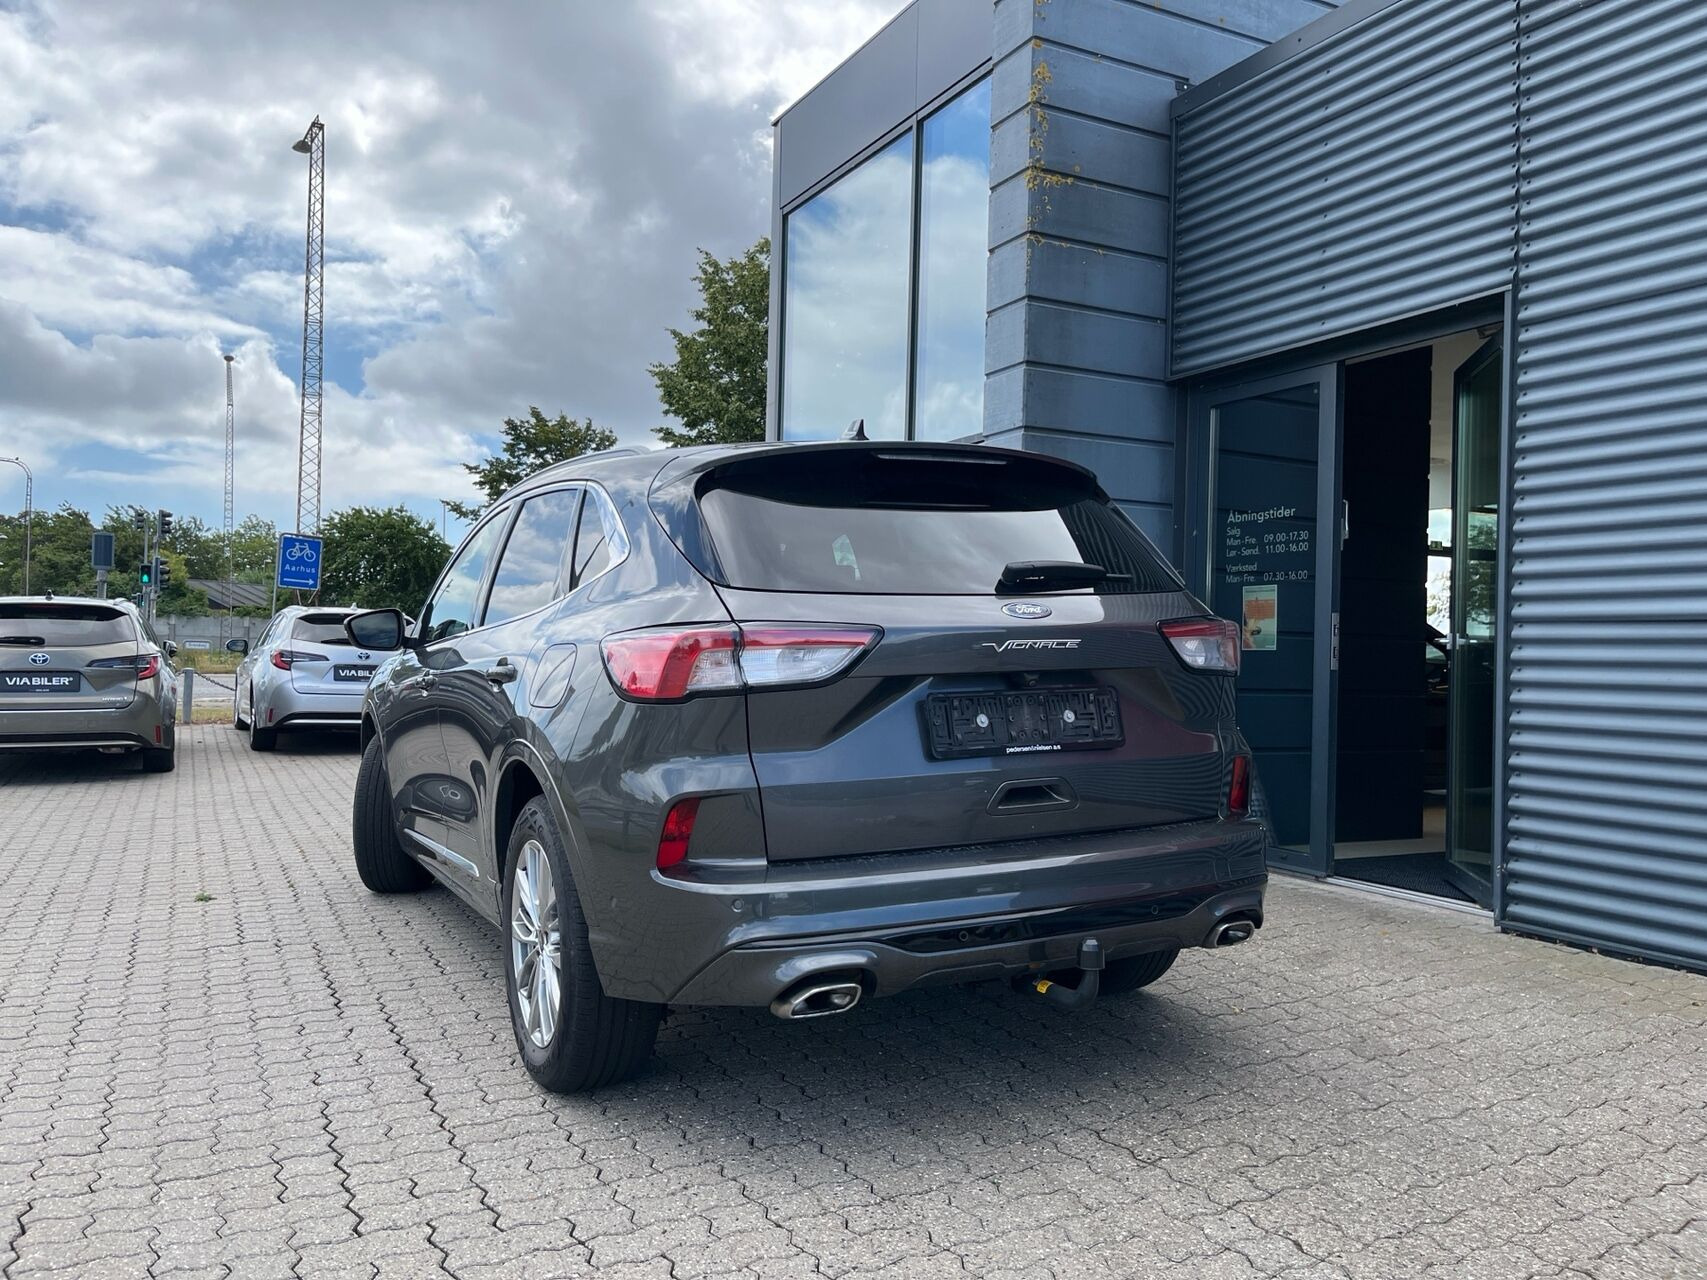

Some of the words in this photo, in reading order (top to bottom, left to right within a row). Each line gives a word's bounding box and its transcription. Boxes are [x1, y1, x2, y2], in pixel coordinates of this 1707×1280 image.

[1227, 505, 1296, 523] Åbningstider
[1226, 526, 1241, 537] Salg
[1263, 530, 1309, 543] 09.00-17.30
[1265, 542, 1309, 554] 11.00-16.00
[284, 563, 316, 574] Aarhus
[1225, 562, 1258, 573] Værksted
[1263, 570, 1308, 582] 07.30-16.00
[1015, 603, 1042, 614] Ford
[981, 638, 1082, 653] VIGNALE
